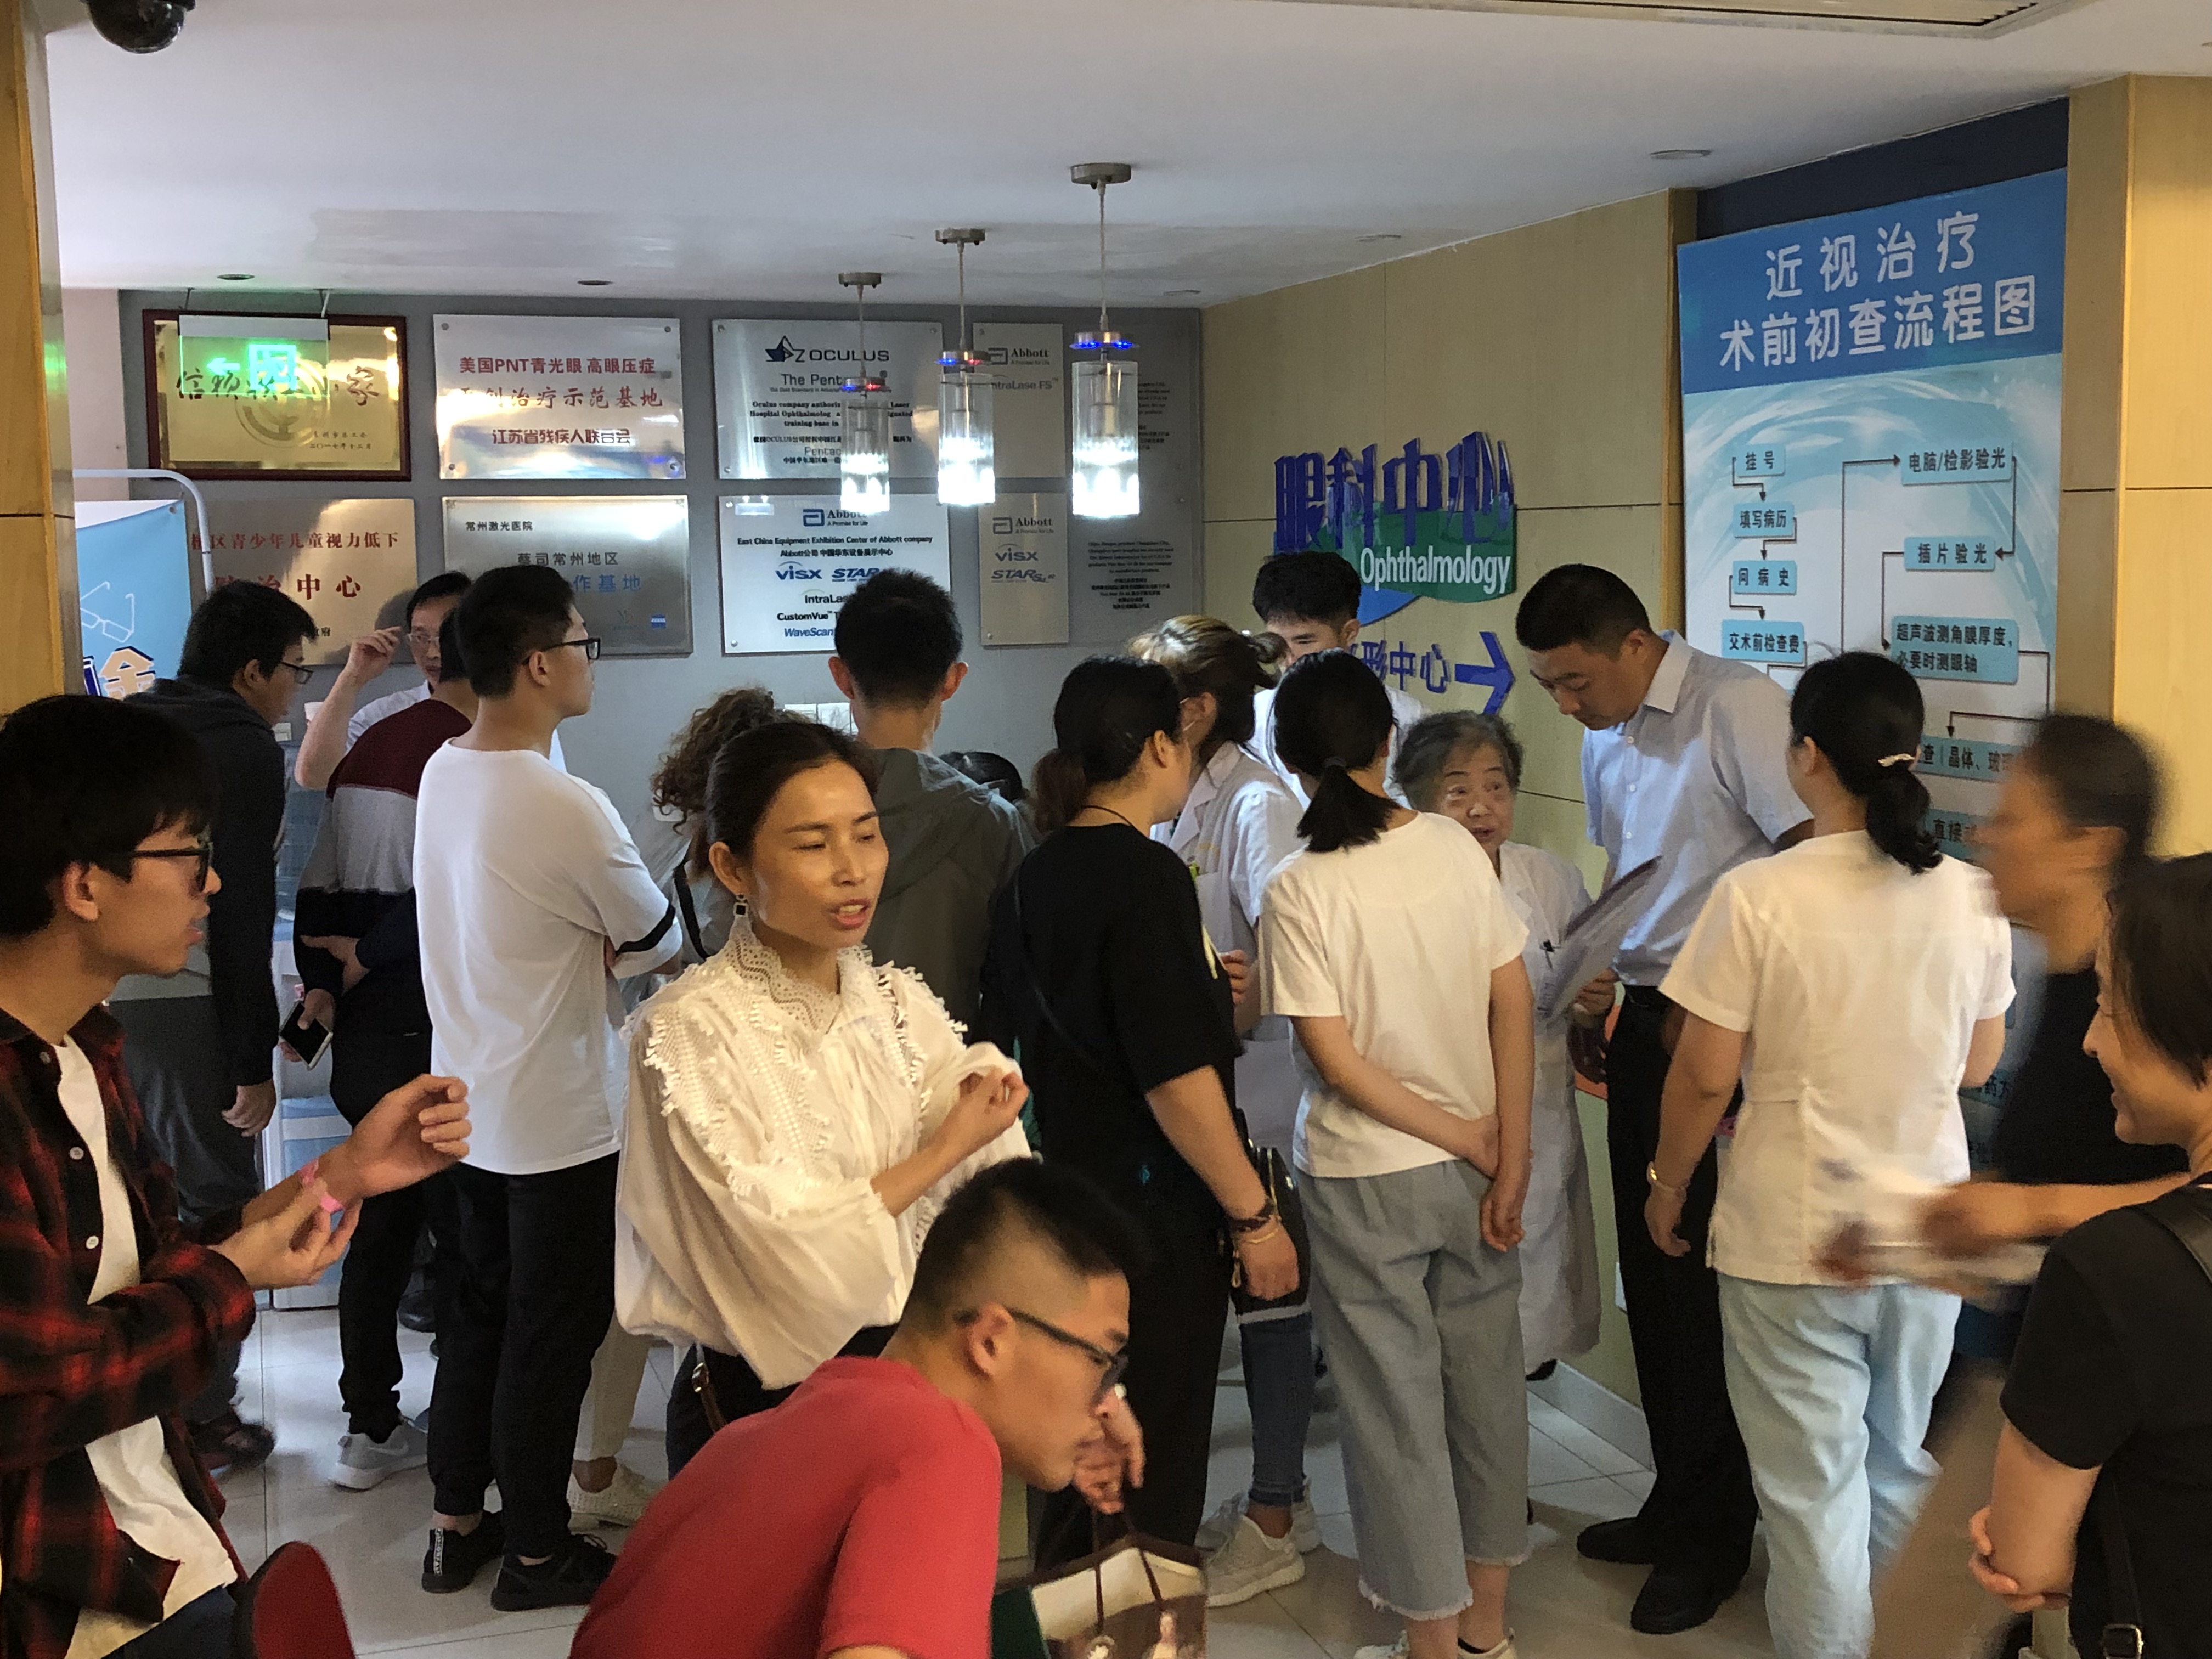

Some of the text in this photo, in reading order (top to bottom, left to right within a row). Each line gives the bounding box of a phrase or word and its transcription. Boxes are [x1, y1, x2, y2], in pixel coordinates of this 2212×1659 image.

[1765, 211, 1979, 301] 近视治疗
[1719, 274, 2035, 371] 术前初查流程图
[809, 349, 889, 362] OCULUS
[1011, 348, 1049, 357] Abbott
[459, 356, 656, 374] 美国PNT青光眼 高眼压症
[781, 374, 843, 386] The Pent
[991, 381, 1036, 390] ntraLase
[804, 445, 842, 456] Pentac
[1909, 447, 2006, 473] 电脑/检影验光
[1745, 450, 1775, 471] 挂号
[1274, 431, 1514, 550] 眼科中心
[465, 521, 533, 531] 常州激光医院
[1015, 517, 1053, 527] Abbott
[1739, 510, 1787, 530] 填写病历
[775, 537, 810, 546] Equipment
[780, 549, 819, 557] Abbott公司
[1917, 543, 1987, 565] 插片验光
[1360, 545, 1511, 595] Ophthalmology
[1738, 567, 1790, 588] 问病史
[571, 573, 641, 593] 作基地
[805, 595, 848, 604] IntraLas
[1729, 631, 1800, 655] 交术前检查费
